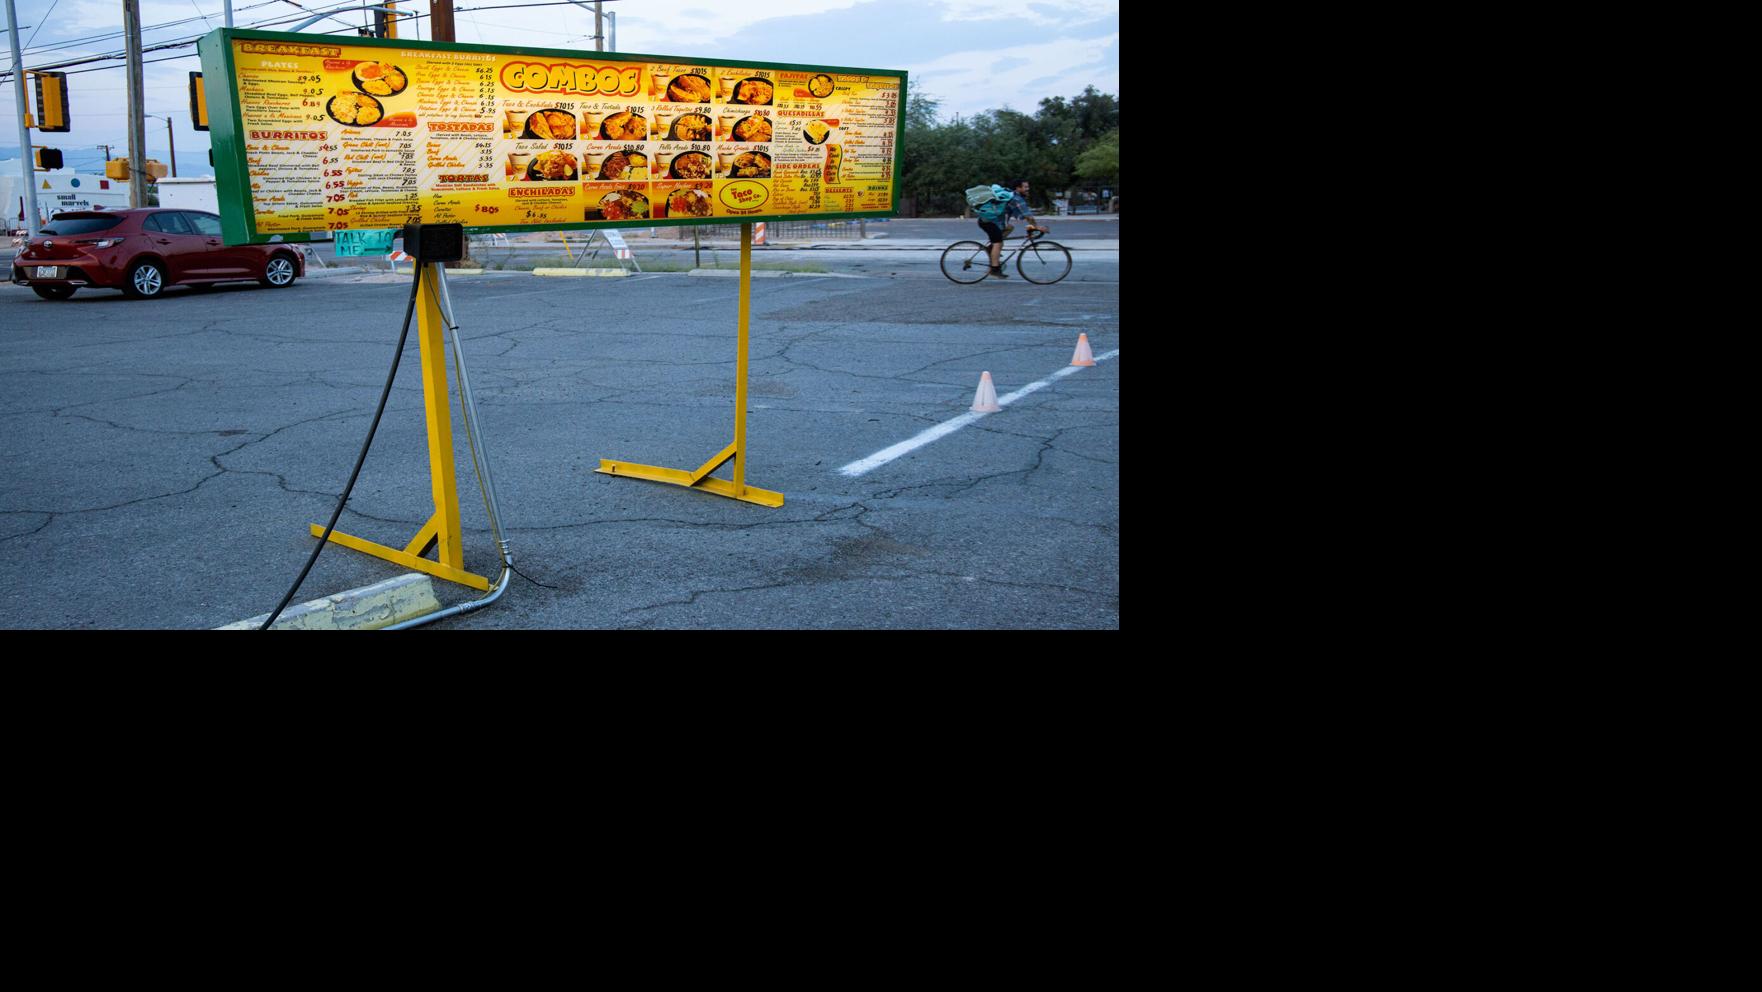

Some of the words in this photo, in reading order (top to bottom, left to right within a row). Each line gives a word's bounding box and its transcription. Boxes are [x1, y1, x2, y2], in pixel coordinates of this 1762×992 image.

[241, 43, 341, 58] BREAKFAST
[401, 50, 450, 60] BREAKFAST
[500, 61, 641, 97] COMBOS
[428, 122, 494, 132] TOSTADAS
[250, 131, 328, 140] BURRITOS
[438, 174, 490, 182] TORTAS
[508, 187, 575, 198] ENCHILADAS
[732, 188, 752, 199] Taco
[336, 230, 366, 244] TALK
[378, 231, 395, 244] TO
